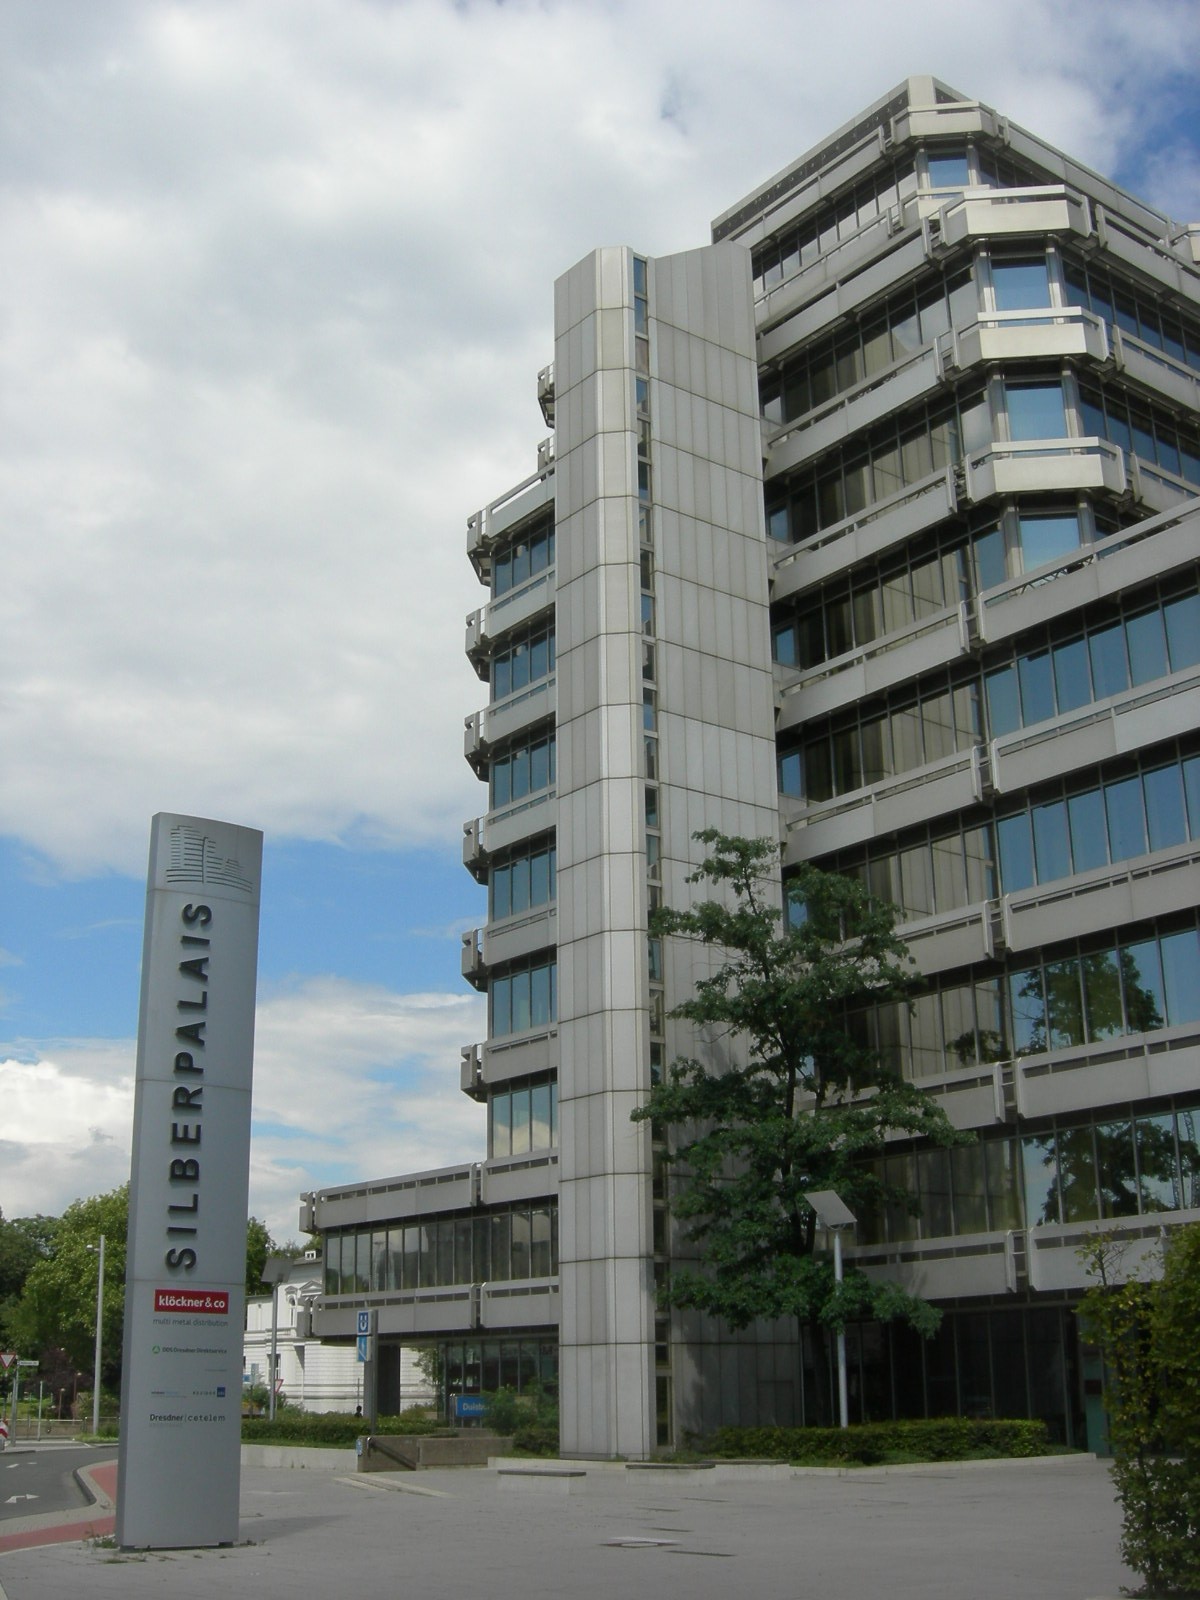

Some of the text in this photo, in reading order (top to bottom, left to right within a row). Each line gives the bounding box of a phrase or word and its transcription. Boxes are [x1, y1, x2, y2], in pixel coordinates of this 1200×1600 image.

[166, 904, 212, 1269] SILBERPALAIS
[158, 1295, 225, 1309] klöckner & co
[152, 1317, 228, 1327] multi metal distribution
[149, 1413, 226, 1422] Dresdner cetelem
